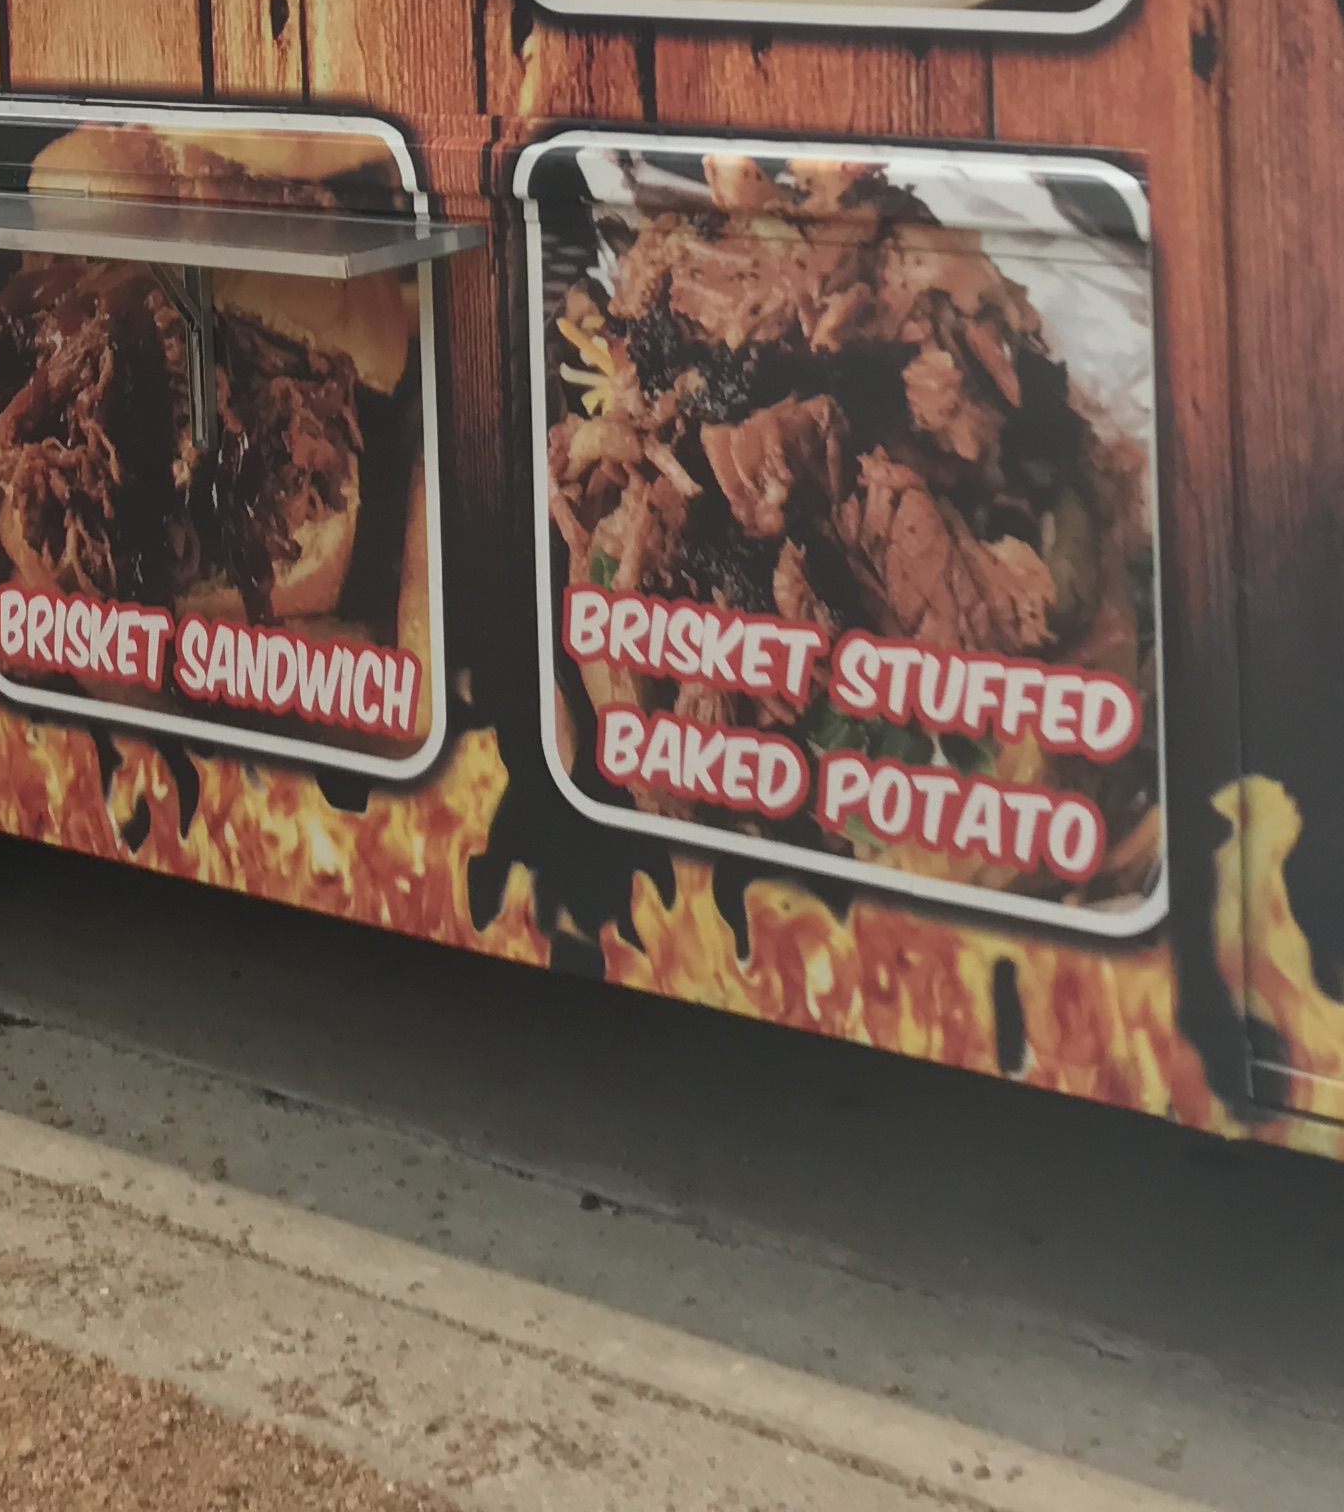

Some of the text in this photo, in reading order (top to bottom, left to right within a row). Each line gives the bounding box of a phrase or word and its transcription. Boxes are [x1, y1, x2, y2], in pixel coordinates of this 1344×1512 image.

[0, 588, 417, 734] BRISKET SANDWICH
[568, 589, 1135, 753] BRISKET STUFFED
[602, 710, 1100, 874] BAKED POTATO
